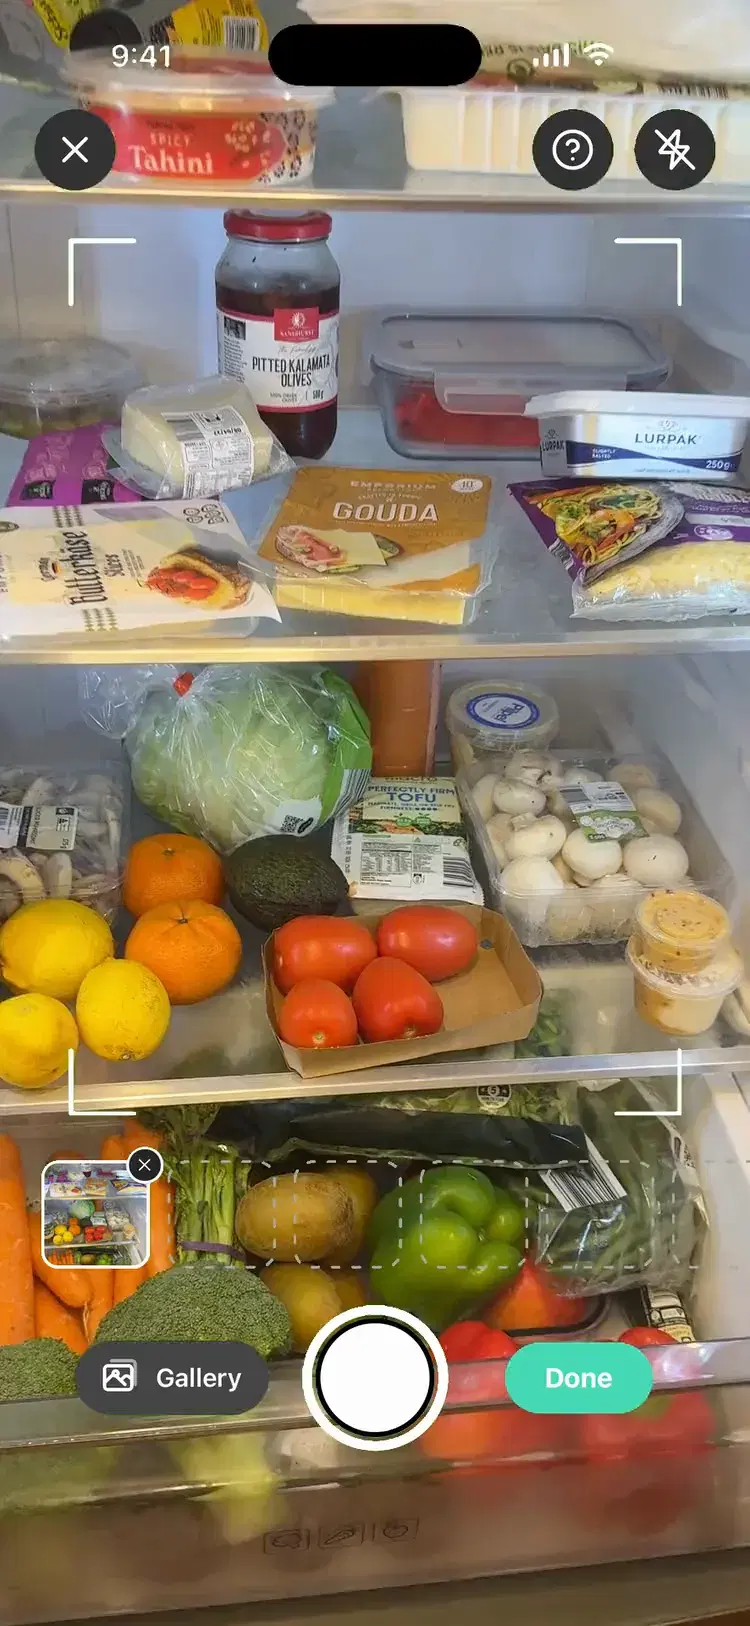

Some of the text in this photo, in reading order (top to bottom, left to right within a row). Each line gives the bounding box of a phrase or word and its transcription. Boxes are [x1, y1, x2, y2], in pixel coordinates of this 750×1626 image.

[128, 144, 214, 175] Tahini
[252, 355, 287, 373] PITTED
[289, 354, 331, 373] KALAMATA
[281, 372, 313, 388] OLIVES
[635, 432, 698, 446] LURPAK
[706, 459, 730, 471] 250g
[332, 501, 439, 522] GOUDA
[59, 530, 108, 605] Butterkäse
[367, 785, 456, 796] PERFECTLY FIRM
[386, 792, 437, 803] TOFU
